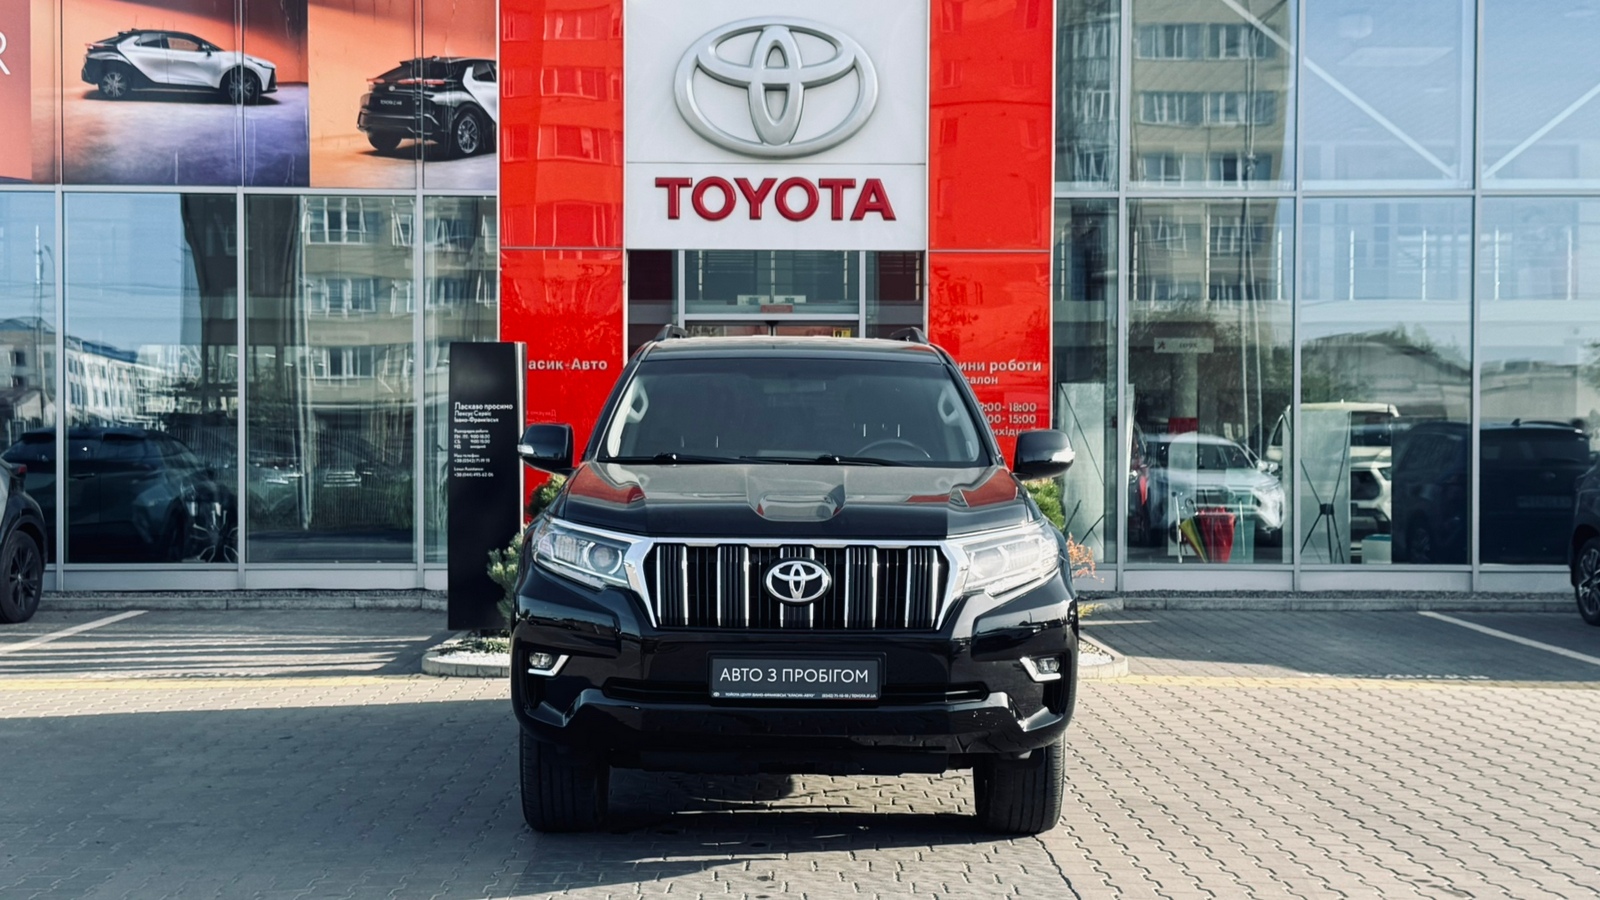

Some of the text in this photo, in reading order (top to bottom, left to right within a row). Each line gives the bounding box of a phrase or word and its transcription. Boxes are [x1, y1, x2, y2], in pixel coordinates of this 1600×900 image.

[655, 176, 897, 222] TOYOTA
[989, 359, 1042, 374] роботи
[454, 402, 484, 410] Ласкаво
[719, 667, 869, 683] АВТО З ПРОБІГОМ
